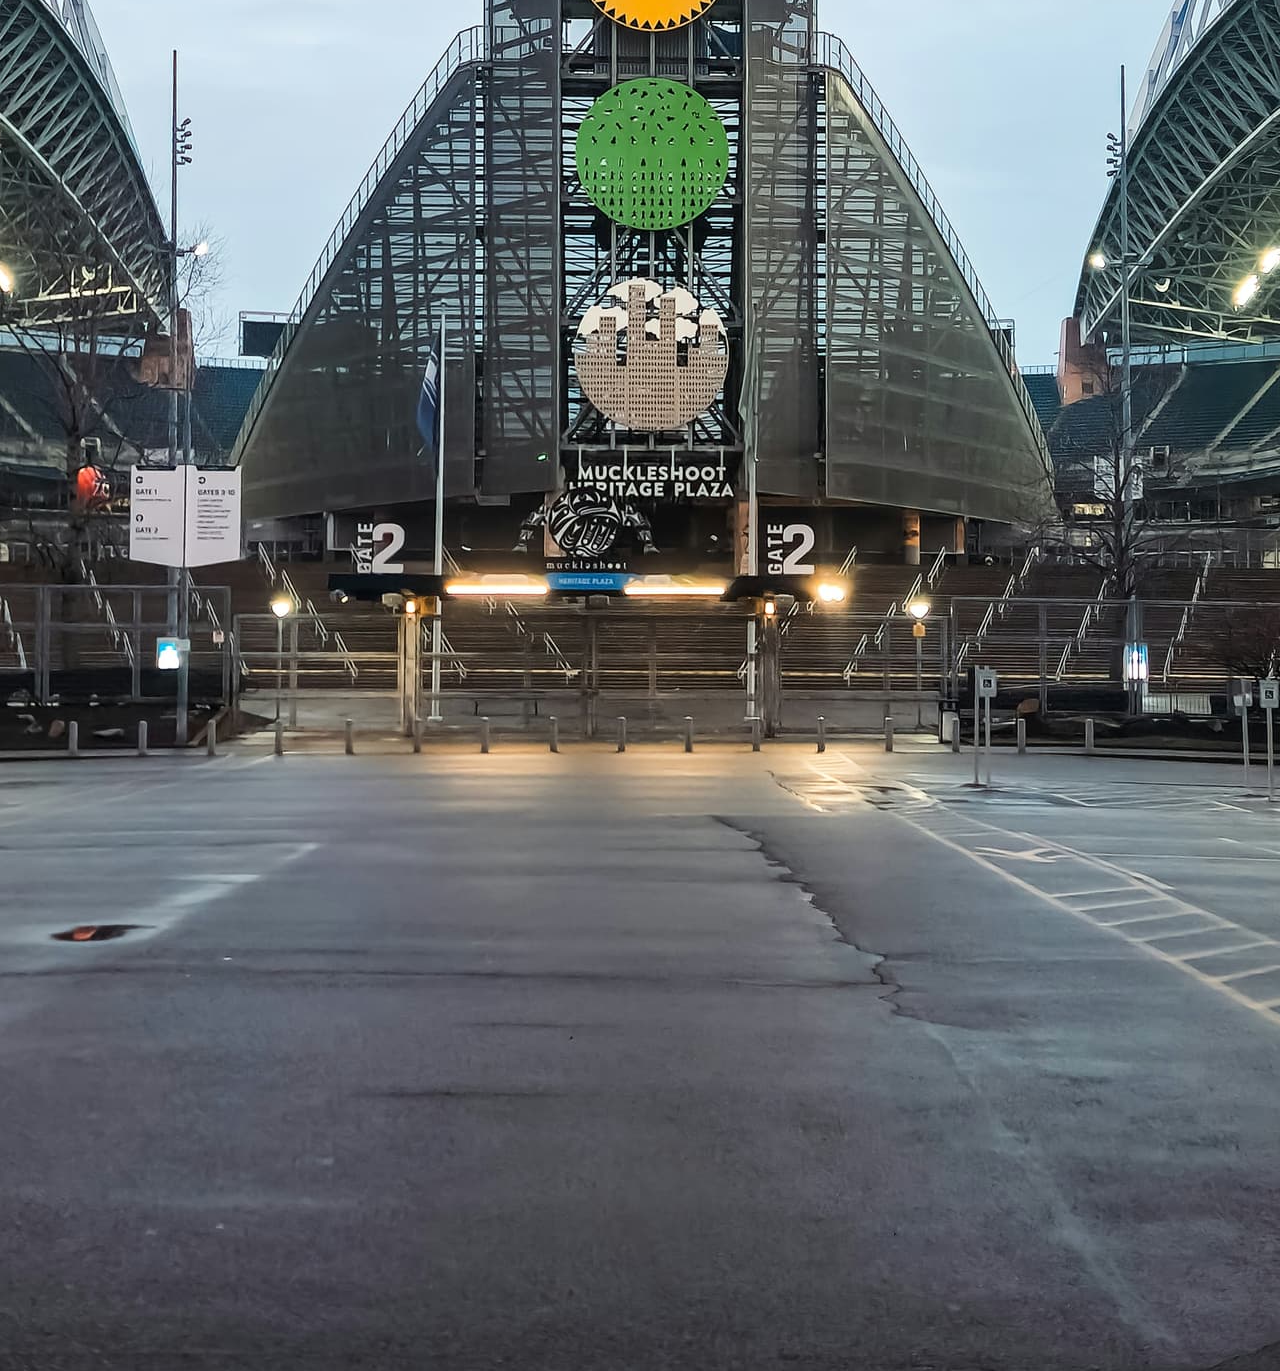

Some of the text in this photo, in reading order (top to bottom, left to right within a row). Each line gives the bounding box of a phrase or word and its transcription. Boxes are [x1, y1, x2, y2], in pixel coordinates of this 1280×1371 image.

[577, 465, 726, 482] MUCKLESHOOT
[135, 488, 152, 496] GATE
[674, 481, 735, 498] PLAZA
[357, 523, 405, 574] GATE 2
[767, 524, 815, 575] GATE 2
[558, 577, 615, 586] HERITAGE PLAZA
